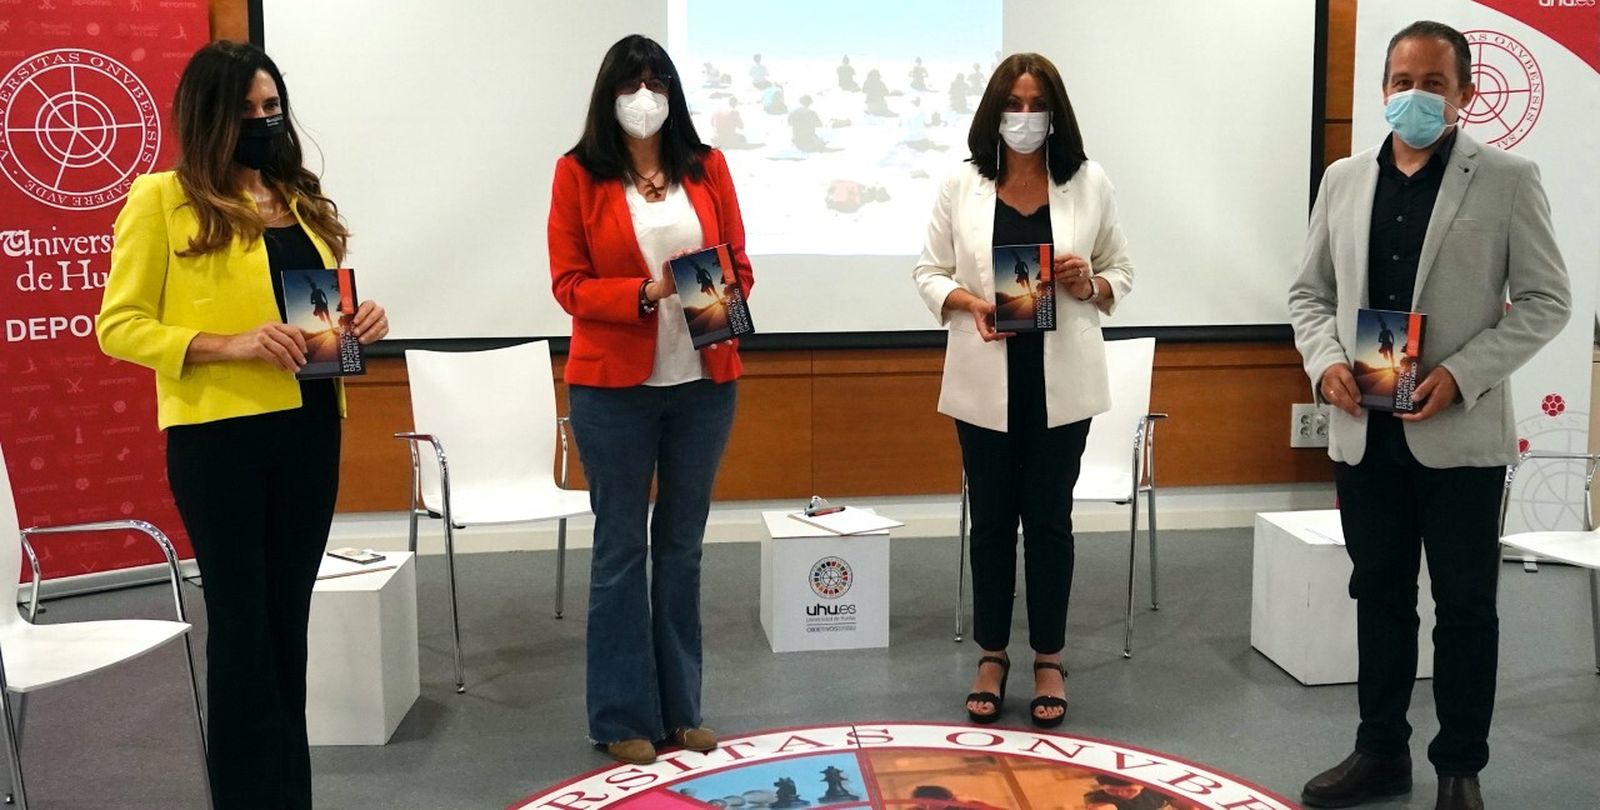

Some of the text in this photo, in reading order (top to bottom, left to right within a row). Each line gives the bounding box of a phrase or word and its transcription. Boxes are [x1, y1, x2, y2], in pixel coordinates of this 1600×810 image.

[1494, 36, 1541, 122] ONVBENSIS
[90, 56, 156, 163] ONVBENSIS
[25, 180, 71, 206] AVDE
[16, 261, 53, 292] de
[6, 314, 93, 342] DEPO
[806, 603, 857, 616] uhu.es
